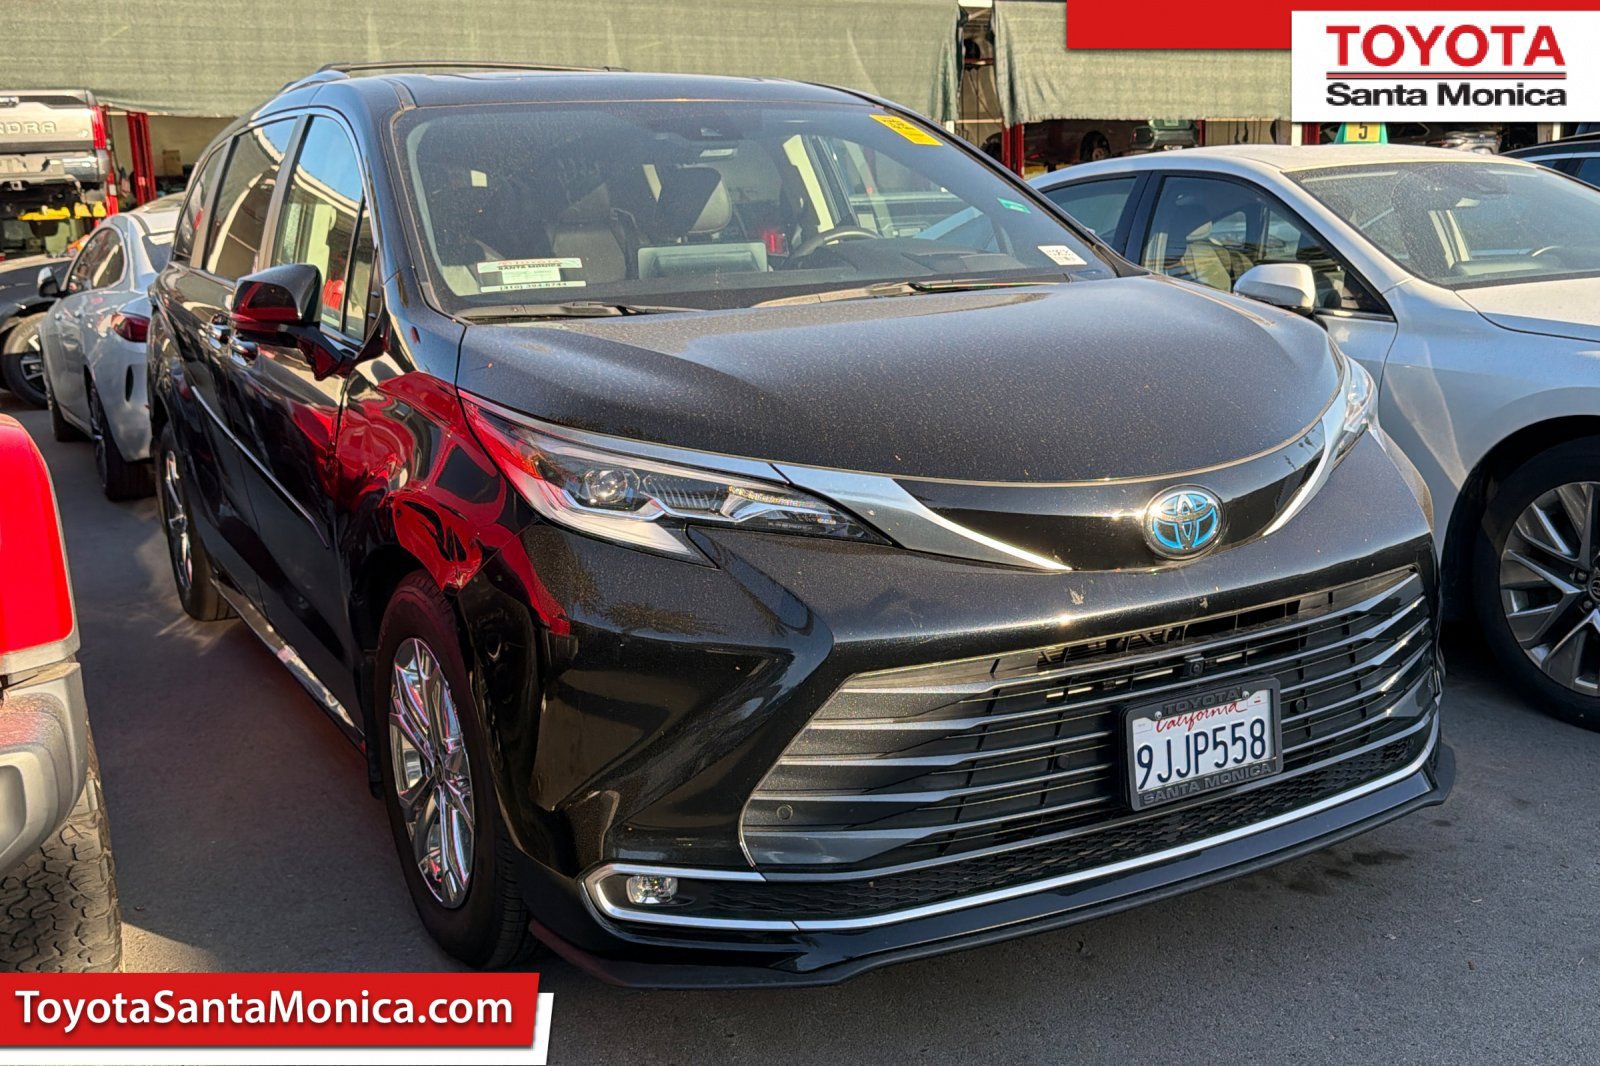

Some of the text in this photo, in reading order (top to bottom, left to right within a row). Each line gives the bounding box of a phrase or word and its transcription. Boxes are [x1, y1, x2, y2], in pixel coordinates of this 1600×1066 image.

[1358, 121, 1368, 140] 5
[1155, 700, 1248, 733] California
[1163, 688, 1239, 714] TOYOTA
[1136, 718, 1266, 790] 9JJP558
[1143, 763, 1273, 804] SANTA MONICA
